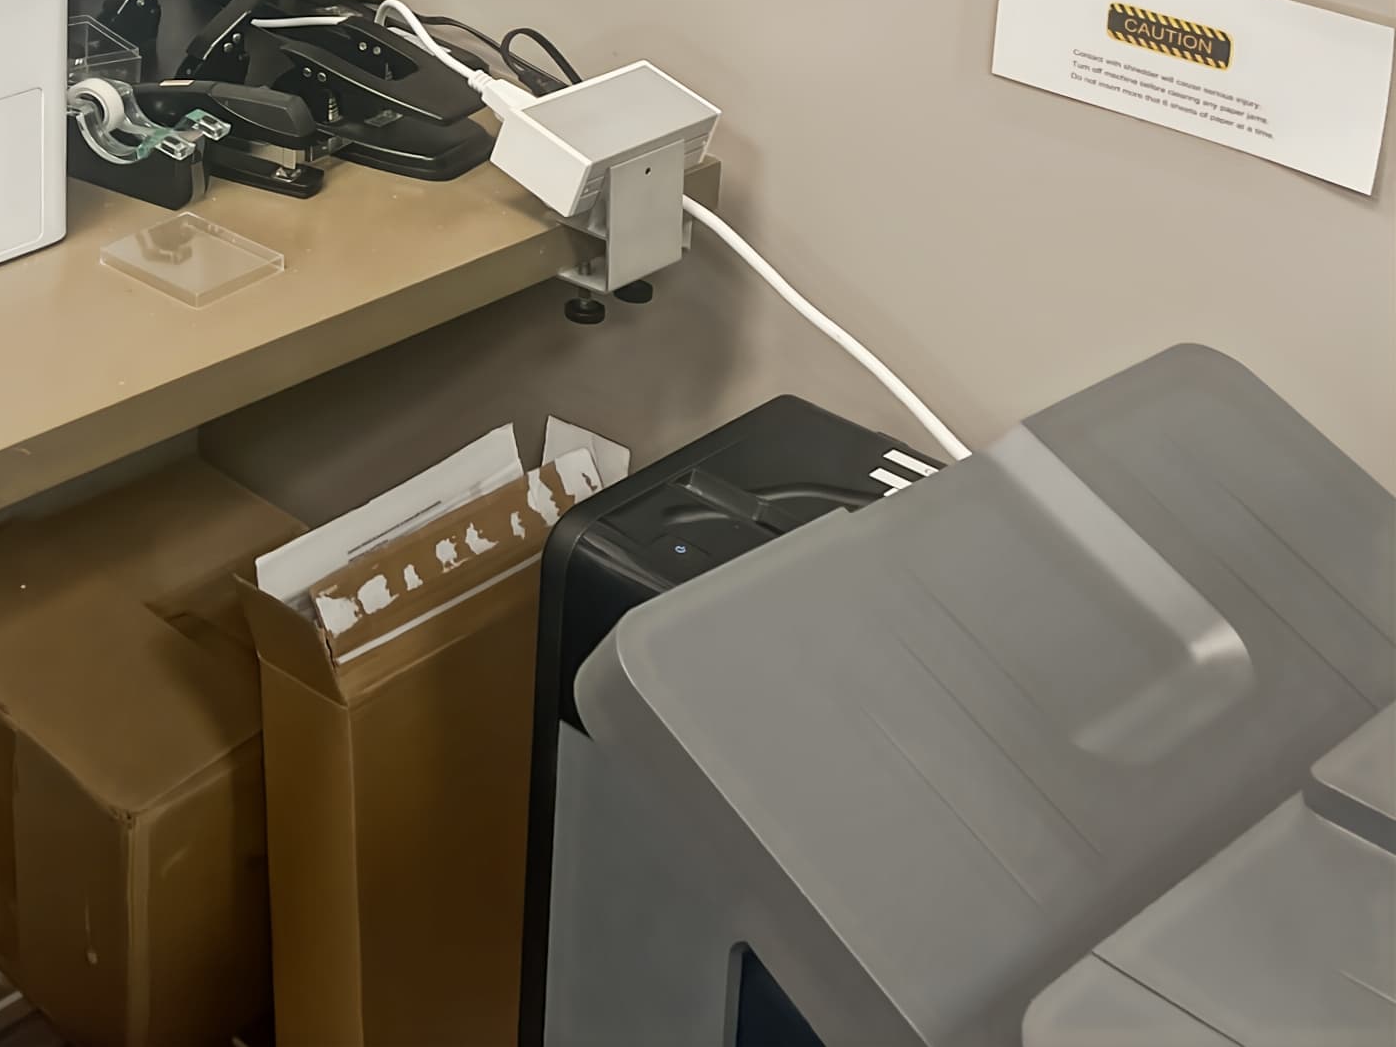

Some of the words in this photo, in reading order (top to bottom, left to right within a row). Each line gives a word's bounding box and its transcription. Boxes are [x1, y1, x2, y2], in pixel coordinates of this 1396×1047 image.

[1124, 18, 1213, 54] CAUTION
[1073, 49, 1103, 62] Contact
[1071, 72, 1082, 81] Do
